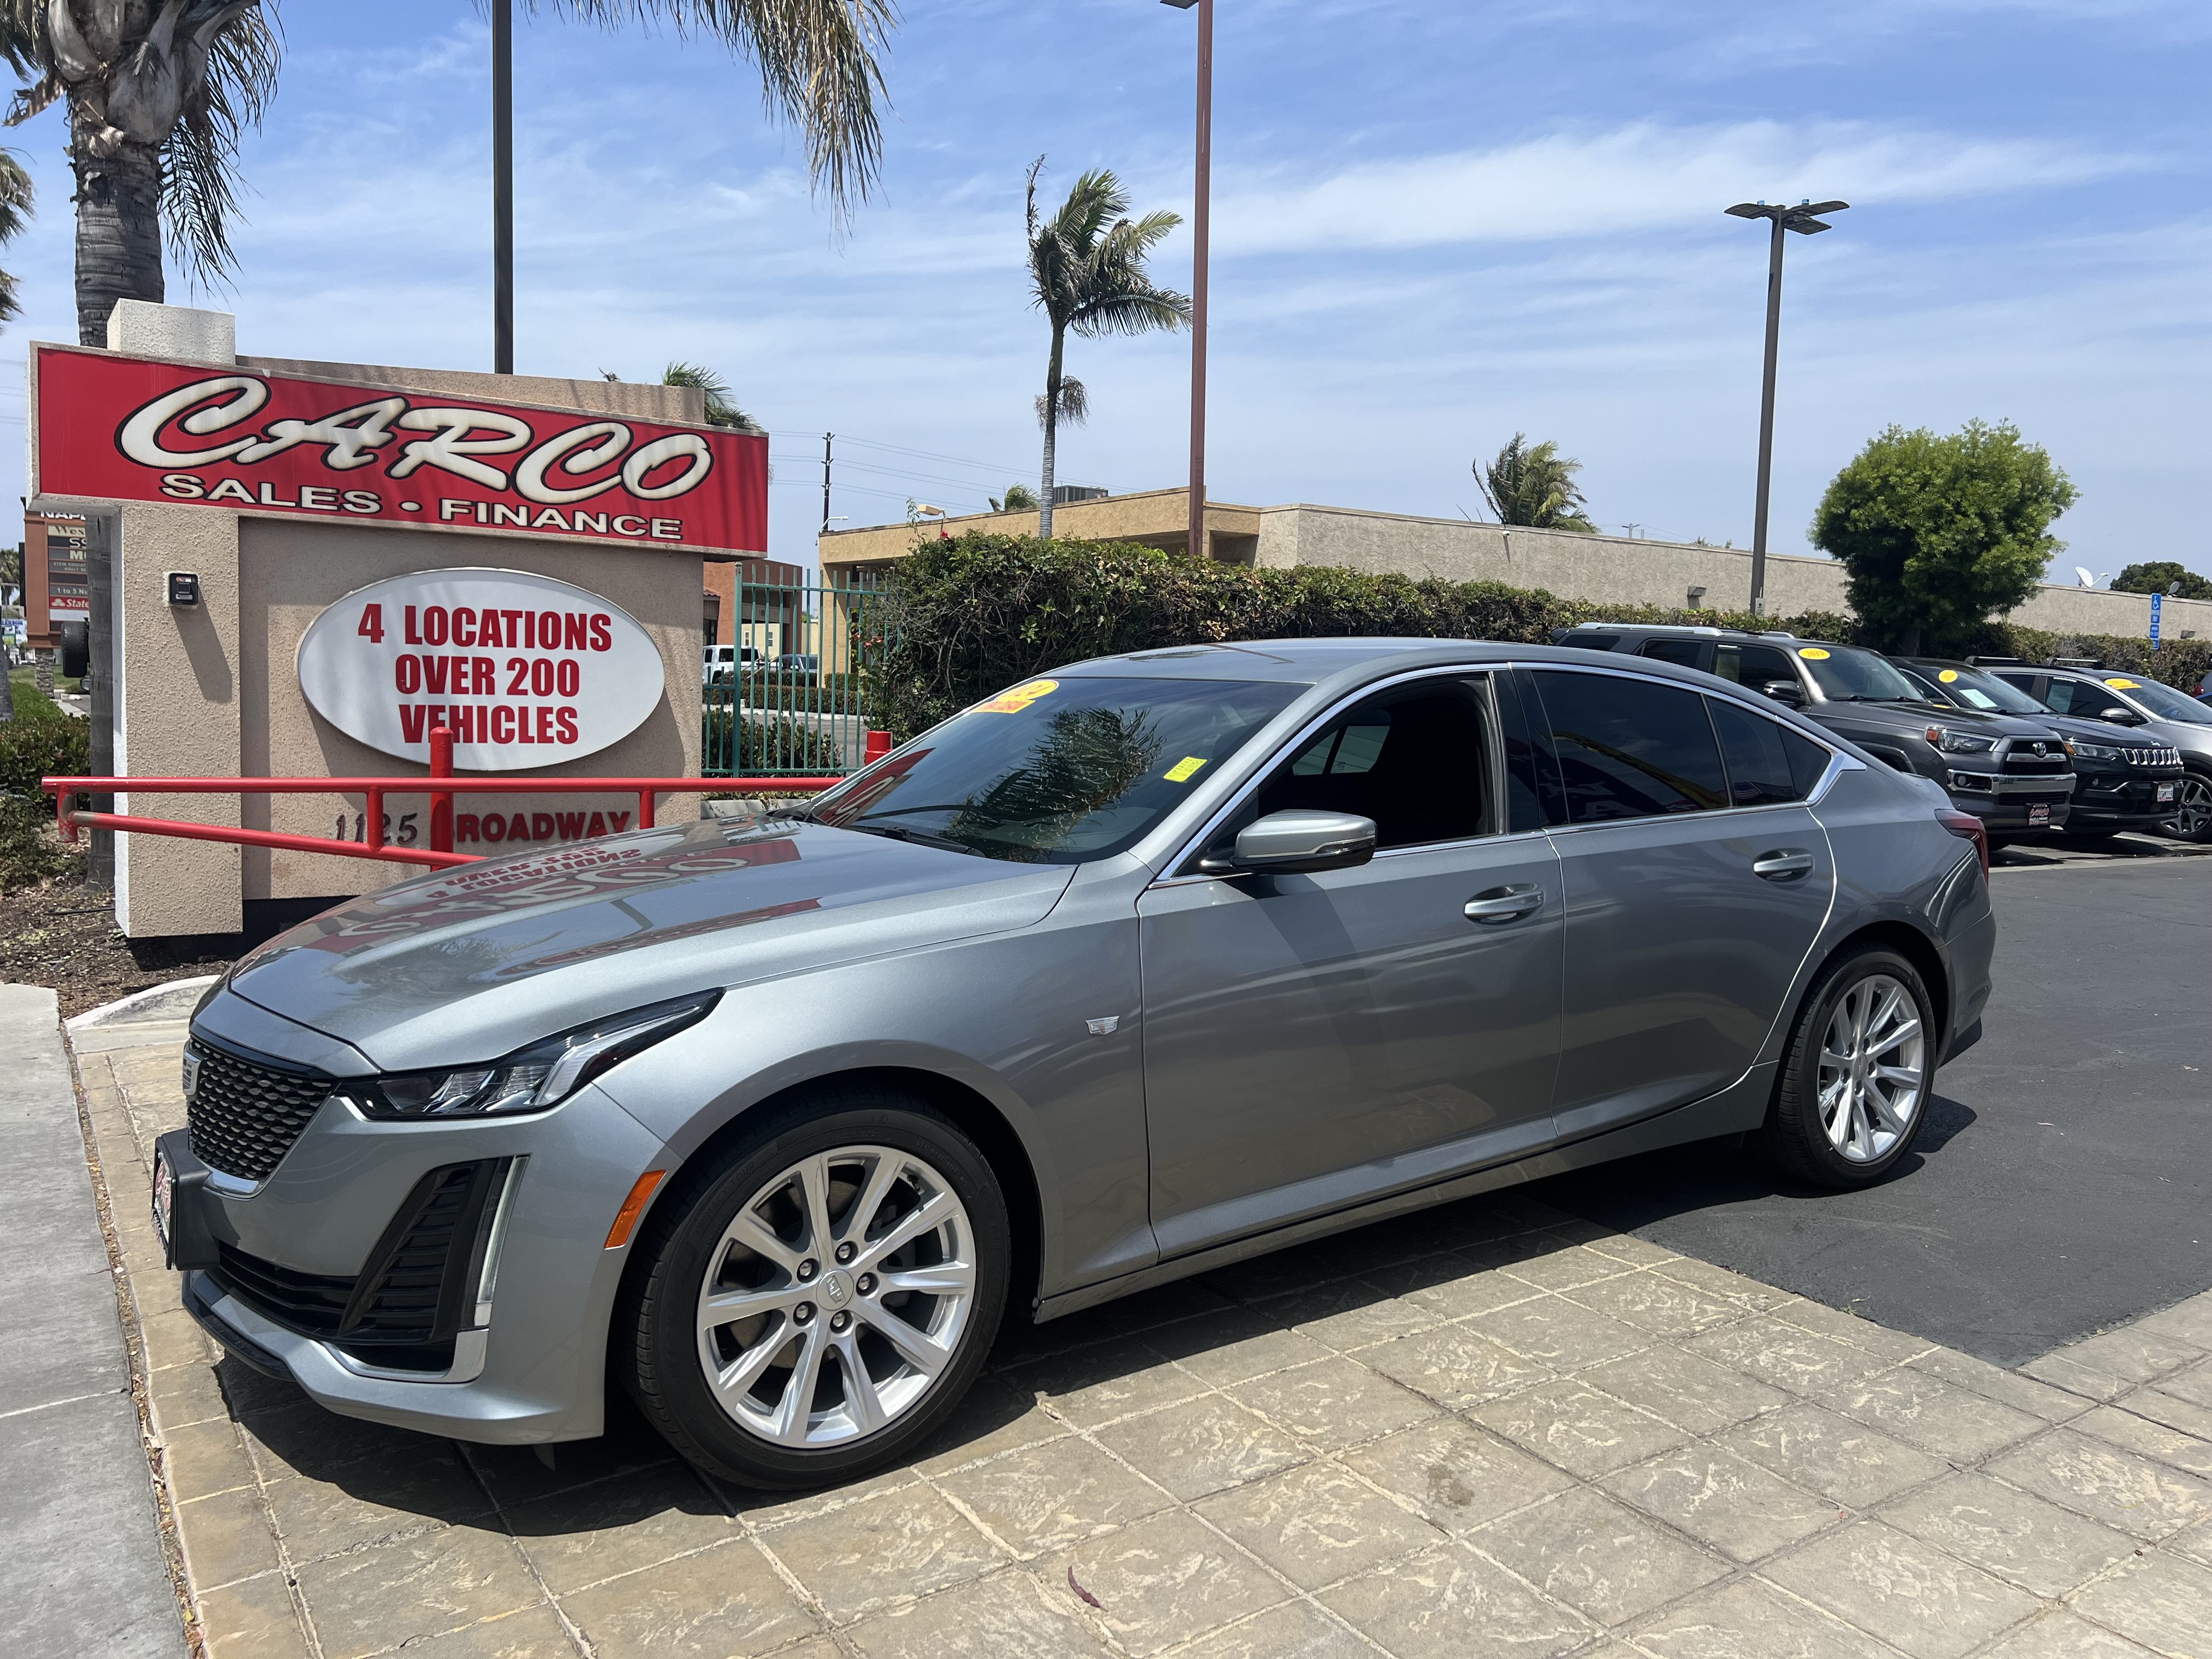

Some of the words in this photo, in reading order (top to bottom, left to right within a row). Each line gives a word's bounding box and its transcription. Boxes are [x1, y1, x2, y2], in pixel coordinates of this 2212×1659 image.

[115, 376, 714, 505] CARCO
[161, 473, 381, 514] SALES
[441, 499, 683, 540] FINANCE
[66, 599, 89, 608] State
[358, 603, 384, 643] 4
[405, 606, 612, 651] LOCATIONS
[396, 654, 495, 695] OVER
[507, 658, 580, 697] 200
[399, 704, 578, 745] VEHICLES
[454, 811, 630, 842] ROADWAY
[731, 1161, 755, 1185] TOUR
